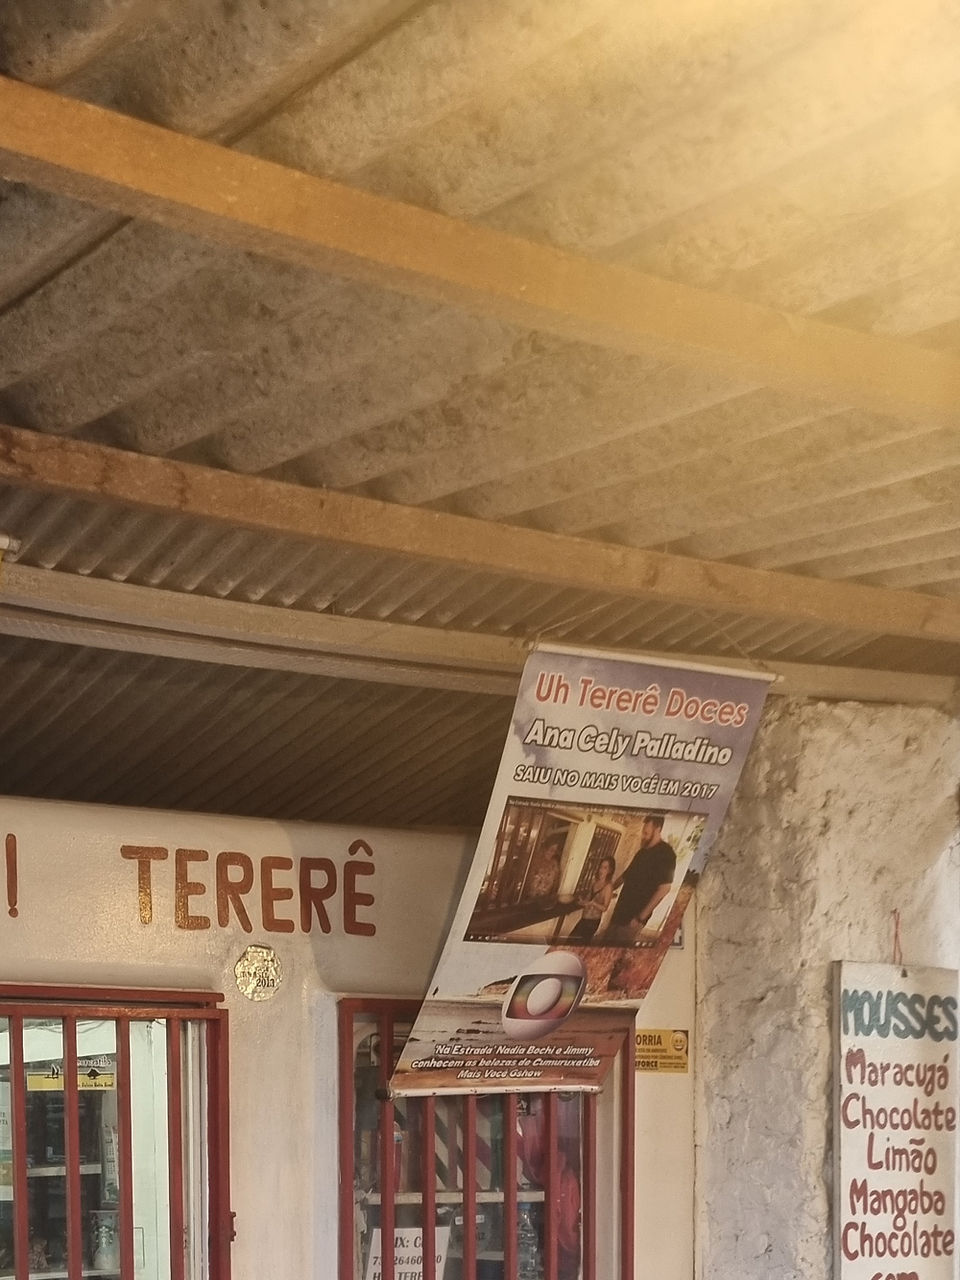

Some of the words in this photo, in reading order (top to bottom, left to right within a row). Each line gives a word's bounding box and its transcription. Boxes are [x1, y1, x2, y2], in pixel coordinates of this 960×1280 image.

[535, 672, 570, 704] Uh
[578, 677, 661, 716] Tererê
[664, 687, 750, 728] Doces
[524, 718, 575, 751] Ana
[576, 724, 631, 760] Cely
[632, 729, 733, 766] Palladino
[513, 764, 553, 785] SAIU
[553, 769, 580, 788] NO
[581, 772, 620, 792] MAIS
[621, 773, 659, 794] VOCÊ
[659, 779, 680, 797] EM
[681, 782, 719, 800] 2017
[119, 838, 376, 937] TERERÊ
[841, 988, 959, 1043] MOUSSES
[563, 1045, 594, 1058] Jimmy
[635, 1034, 663, 1046] ORRIA
[411, 1058, 464, 1069] conhecem
[456, 1069, 481, 1080] Mais
[845, 1048, 950, 1097] Maracujá
[842, 1093, 957, 1132] Chocolate
[867, 1132, 938, 1176] Limão
[849, 1178, 946, 1232] Mangaba
[842, 1221, 955, 1261] Chocolate
